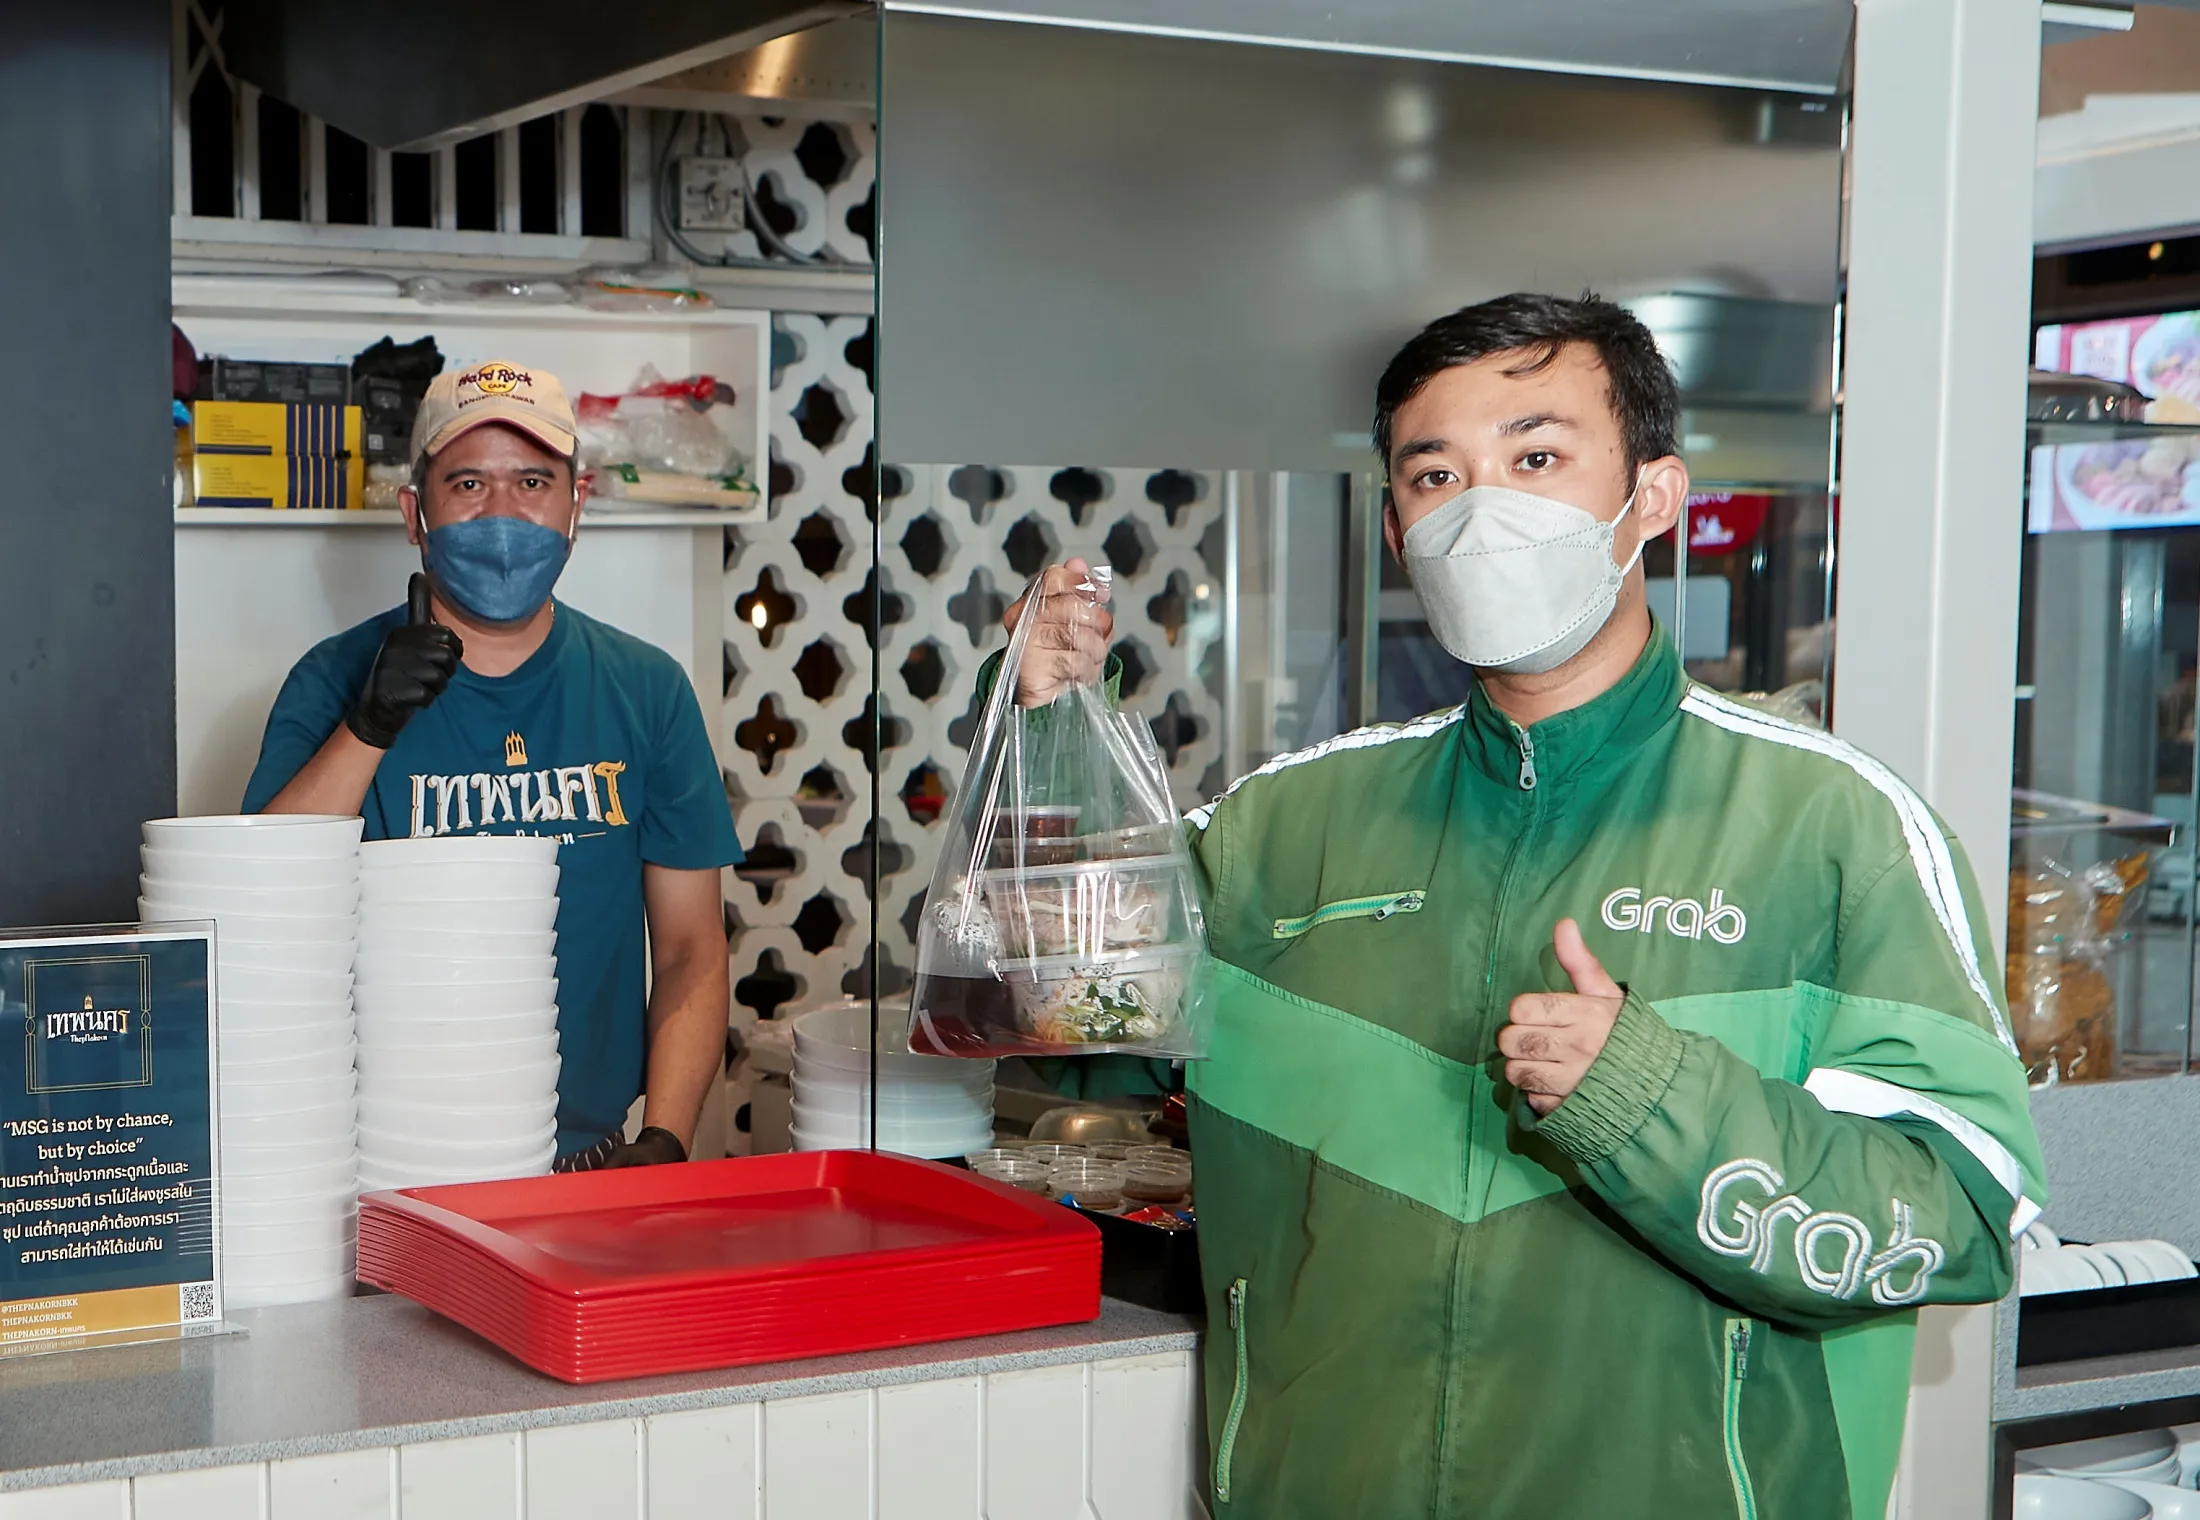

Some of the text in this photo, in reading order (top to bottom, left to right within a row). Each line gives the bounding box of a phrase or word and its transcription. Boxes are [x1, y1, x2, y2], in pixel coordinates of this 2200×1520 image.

[458, 369, 532, 387] Hard Rock
[409, 760, 630, 838] เทพนคร
[1601, 887, 1747, 945] Grab
[47, 1010, 131, 1039] เทพนคร
[52, 1118, 65, 1133] is
[67, 1117, 93, 1132] not
[95, 1115, 114, 1133] by
[116, 1112, 173, 1128] chance,
[38, 1145, 64, 1160] but
[66, 1142, 87, 1160] by
[3, 1224, 21, 1245] ซุป
[1697, 1158, 1946, 1307] Grab
[2, 1298, 79, 1314] @THEPNAKORNBKK
[2, 1311, 73, 1327] THEPNAKORNBKK
